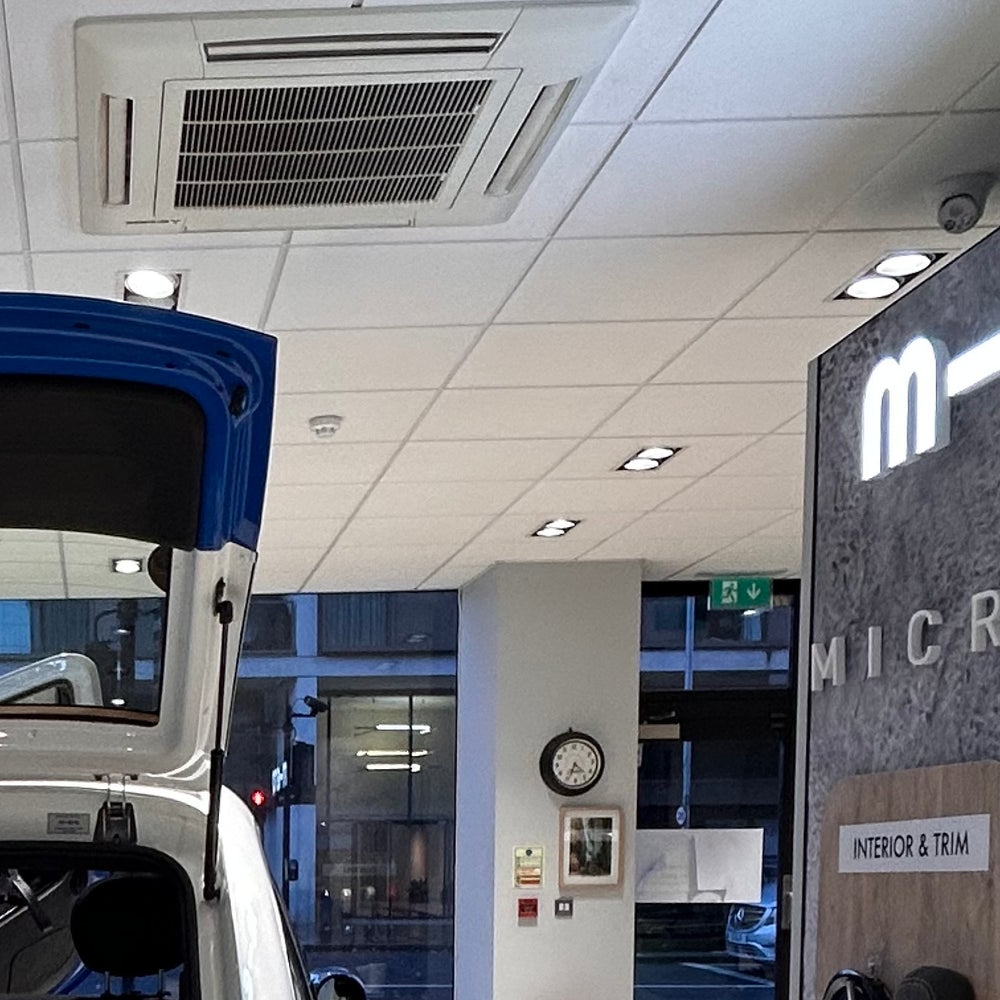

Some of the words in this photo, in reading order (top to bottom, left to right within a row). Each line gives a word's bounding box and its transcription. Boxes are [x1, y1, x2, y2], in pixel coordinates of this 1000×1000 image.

[853, 834, 914, 860] INTERIOR
[918, 833, 929, 857] &
[933, 830, 970, 857] TRIM
